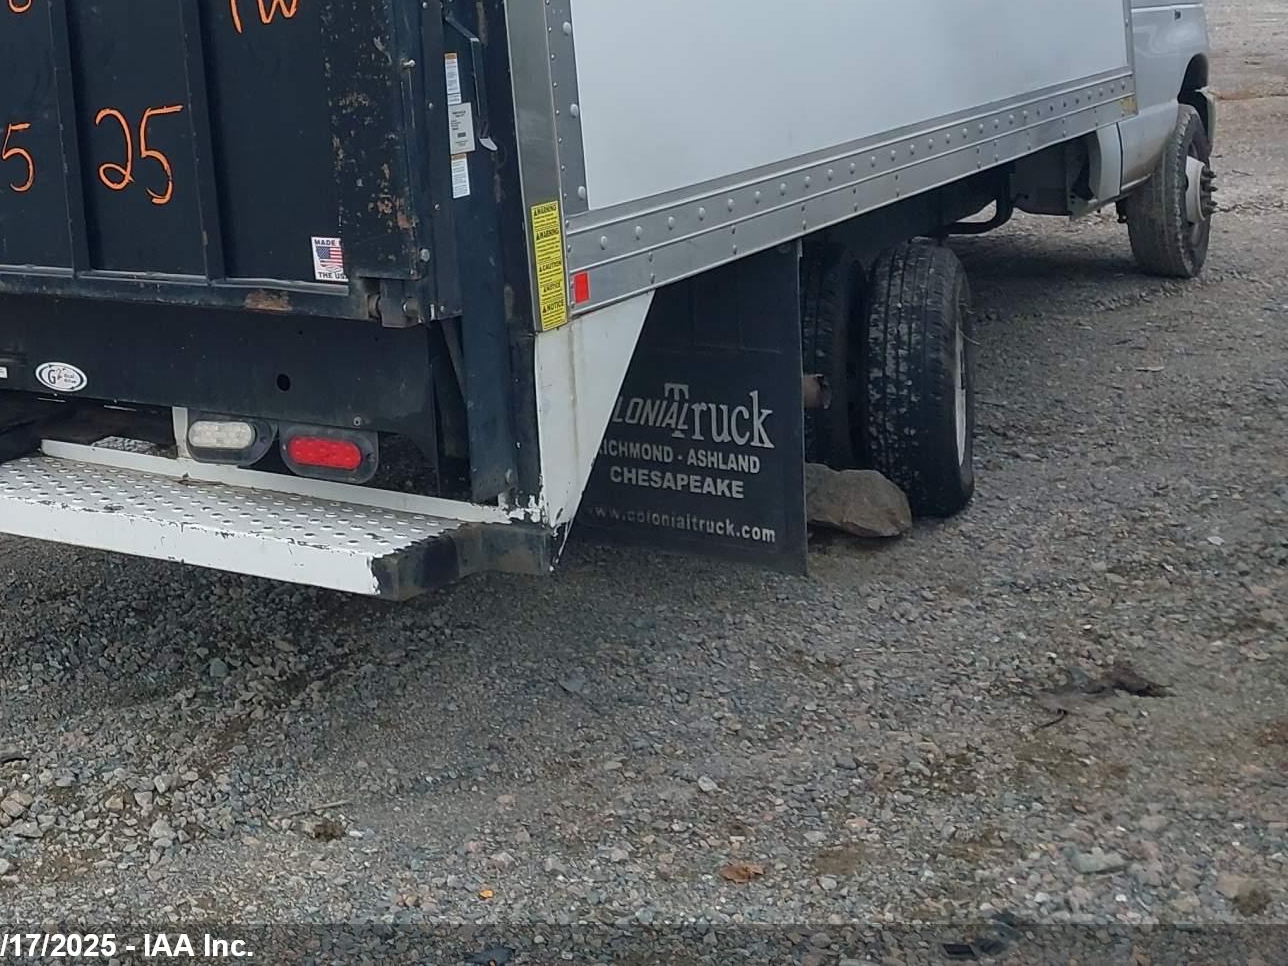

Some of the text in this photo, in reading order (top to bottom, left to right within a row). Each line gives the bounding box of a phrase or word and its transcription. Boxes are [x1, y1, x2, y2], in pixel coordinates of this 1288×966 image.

[96, 104, 183, 204] 25
[612, 395, 689, 430] LONIAL
[687, 448, 761, 474] ASHLAND
[610, 466, 745, 499] CHESAPEAKE
